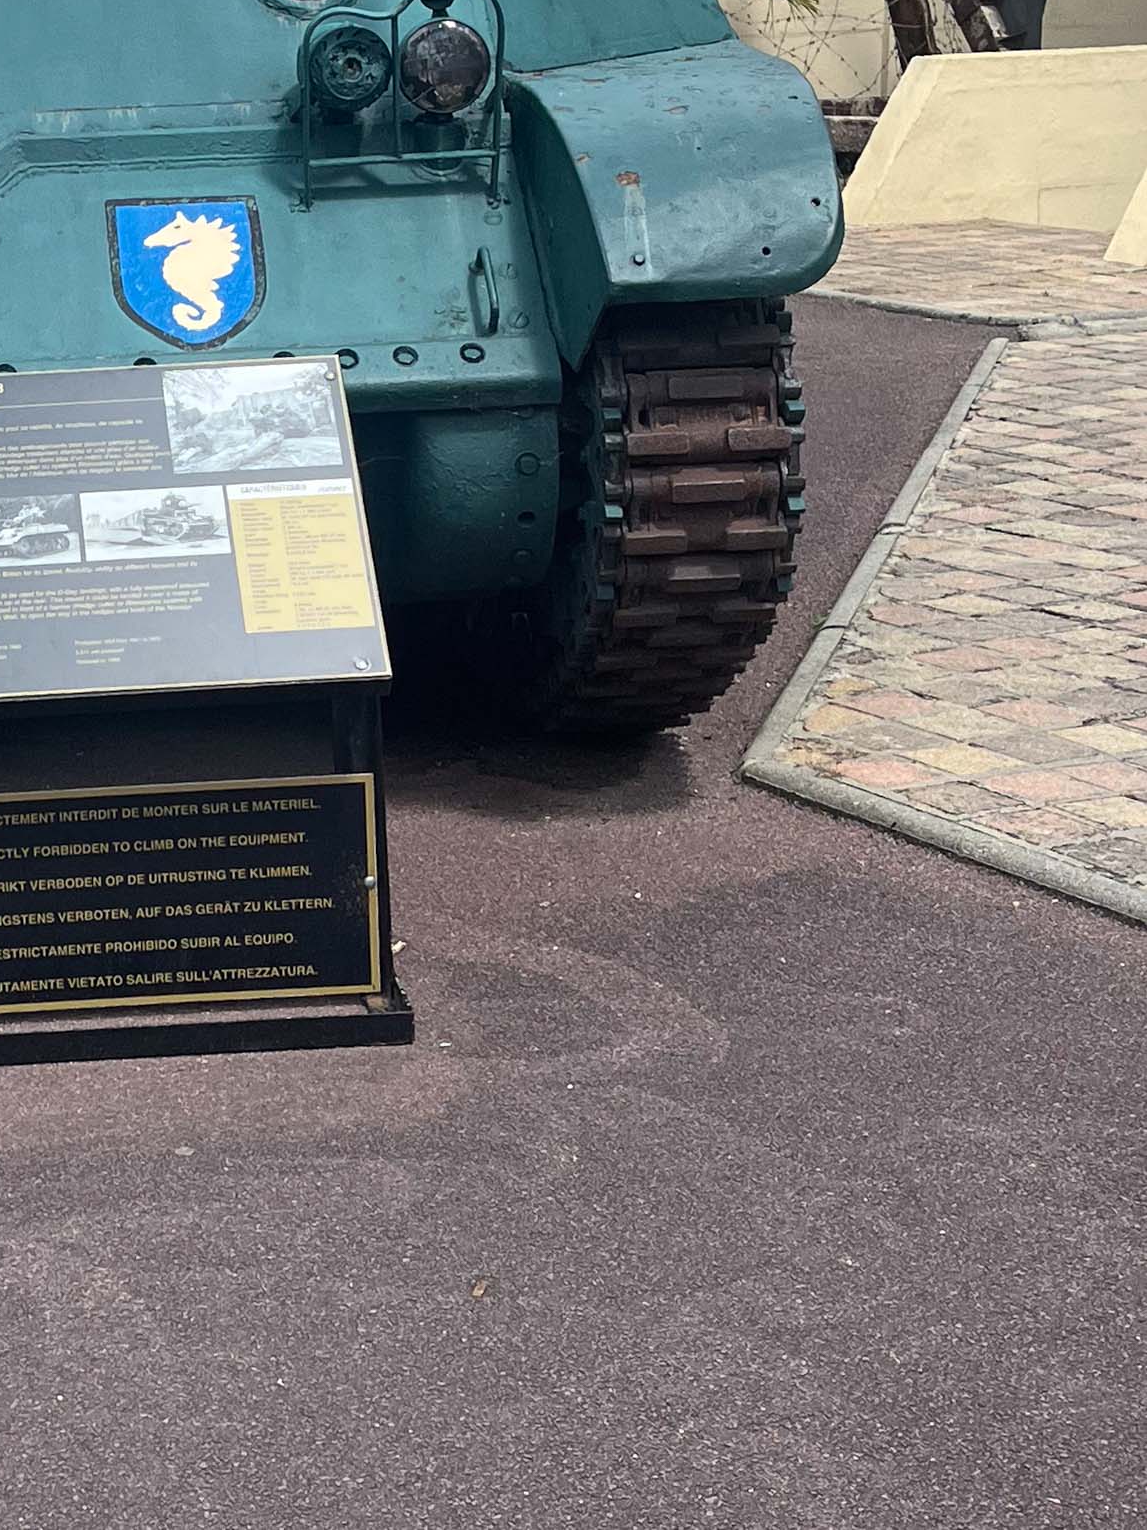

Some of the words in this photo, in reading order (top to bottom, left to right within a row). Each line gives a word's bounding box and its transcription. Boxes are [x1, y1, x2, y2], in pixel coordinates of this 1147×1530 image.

[59, 809, 117, 821] INTERDIT
[122, 807, 139, 818] DE
[143, 805, 198, 816] MONTER
[202, 803, 228, 813] SUR
[232, 801, 248, 812] LE
[252, 799, 320, 810] MATERIEL.
[33, 843, 108, 856] FORBIDDEN
[112, 841, 130, 852] TO
[134, 839, 173, 851] CLIMB
[177, 838, 196, 849] ON
[200, 836, 225, 847] THE
[229, 832, 308, 845] EQUIPMENT.
[30, 877, 101, 890] VERBODEN
[105, 875, 123, 886] OP
[127, 874, 144, 885] DE
[148, 870, 226, 883] UITRUSTING
[229, 868, 246, 879] TE
[250, 866, 312, 878] KLIMMEN.
[136, 906, 161, 918] AUF
[165, 904, 192, 916] DAS
[195, 901, 240, 914] GERÄT
[243, 901, 260, 912] ZU
[105, 939, 176, 952] PROHIBIDO
[180, 936, 220, 948] SUBIR
[224, 935, 241, 946] AL
[67, 975, 122, 988] VIETATO
[126, 972, 172, 984] SALIRE
[176, 965, 317, 981] SULL'ATTREZZATURA.
